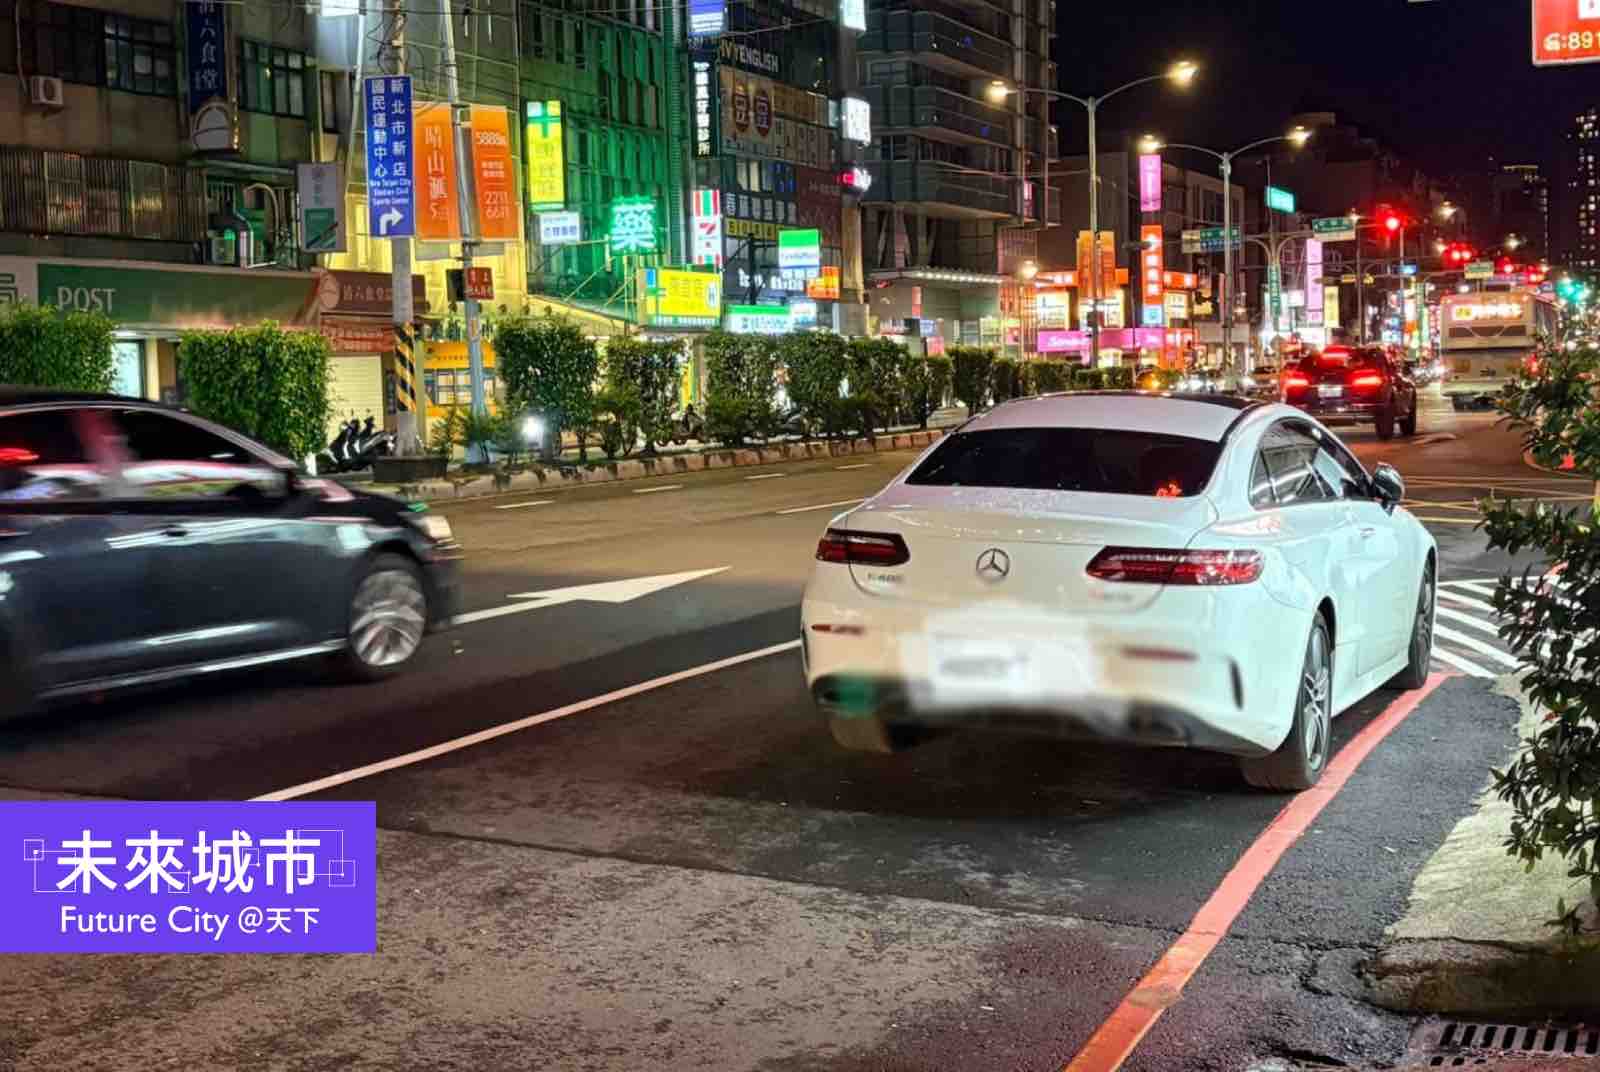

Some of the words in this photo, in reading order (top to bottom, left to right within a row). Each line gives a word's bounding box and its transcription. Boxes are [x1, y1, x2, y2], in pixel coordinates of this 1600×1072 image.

[371, 79, 388, 177] 國民運動中心
[391, 79, 407, 176] 新北市新店
[57, 286, 116, 315] POST
